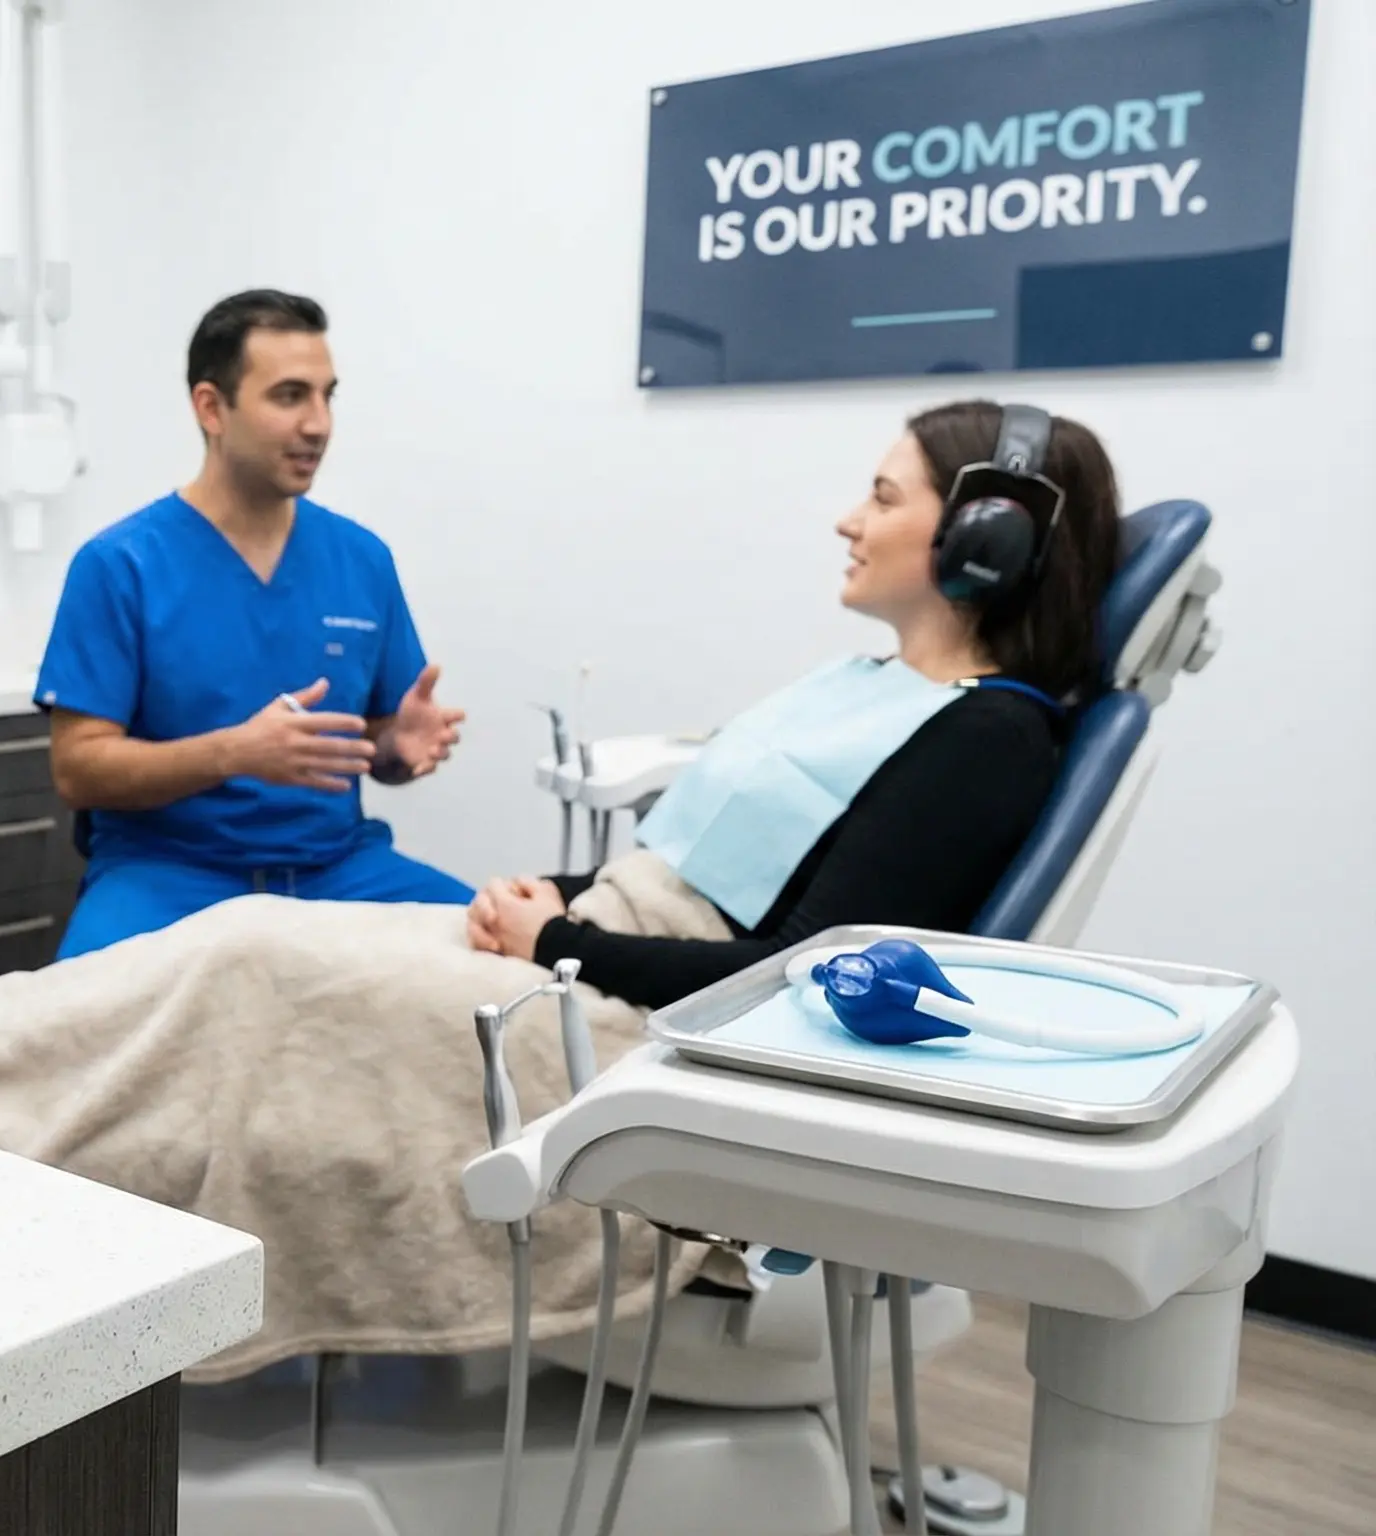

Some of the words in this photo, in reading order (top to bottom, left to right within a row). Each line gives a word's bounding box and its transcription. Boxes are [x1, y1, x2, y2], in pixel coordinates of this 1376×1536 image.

[704, 139, 862, 203] YOUR
[871, 90, 1205, 183] COMFORT
[697, 212, 746, 262] IS
[752, 198, 878, 256] OUR
[888, 158, 1208, 244] PRIORITY.
